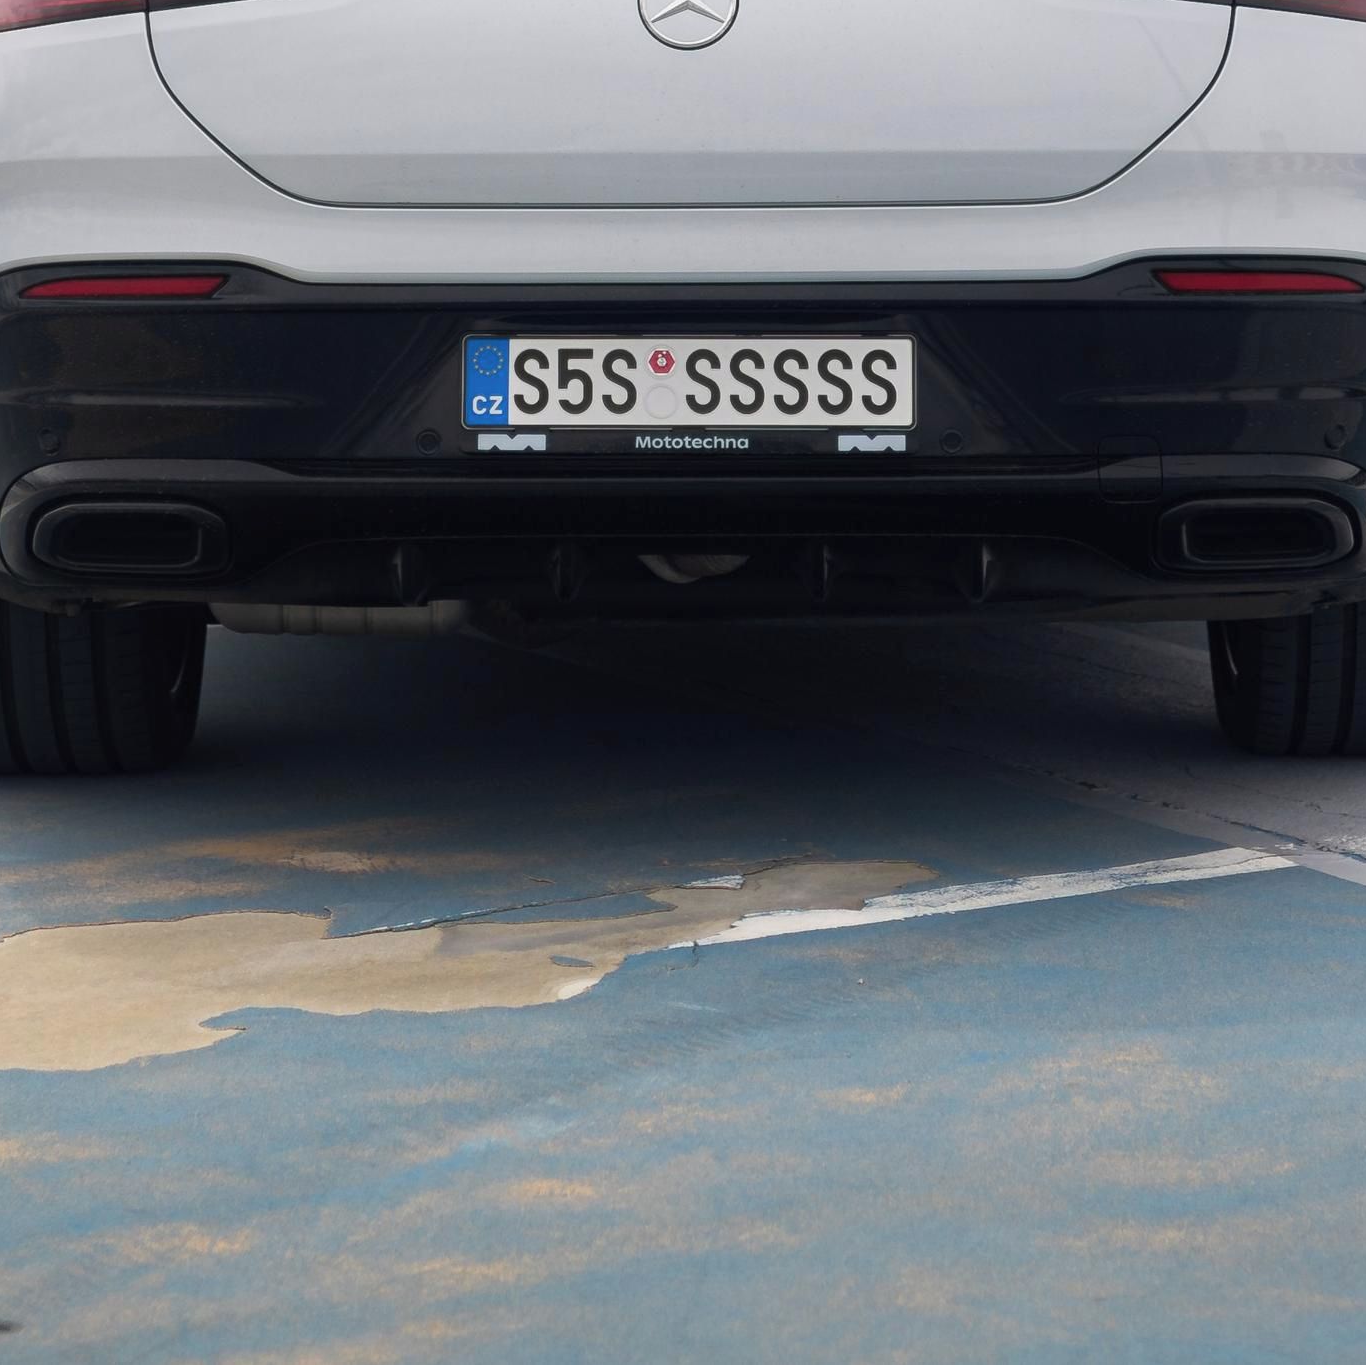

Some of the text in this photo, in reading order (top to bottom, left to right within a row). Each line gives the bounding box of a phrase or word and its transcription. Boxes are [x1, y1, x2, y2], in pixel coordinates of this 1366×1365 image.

[513, 348, 897, 415] S5S SSSSS
[472, 395, 503, 415] CZ
[635, 436, 749, 449] Mototechna
